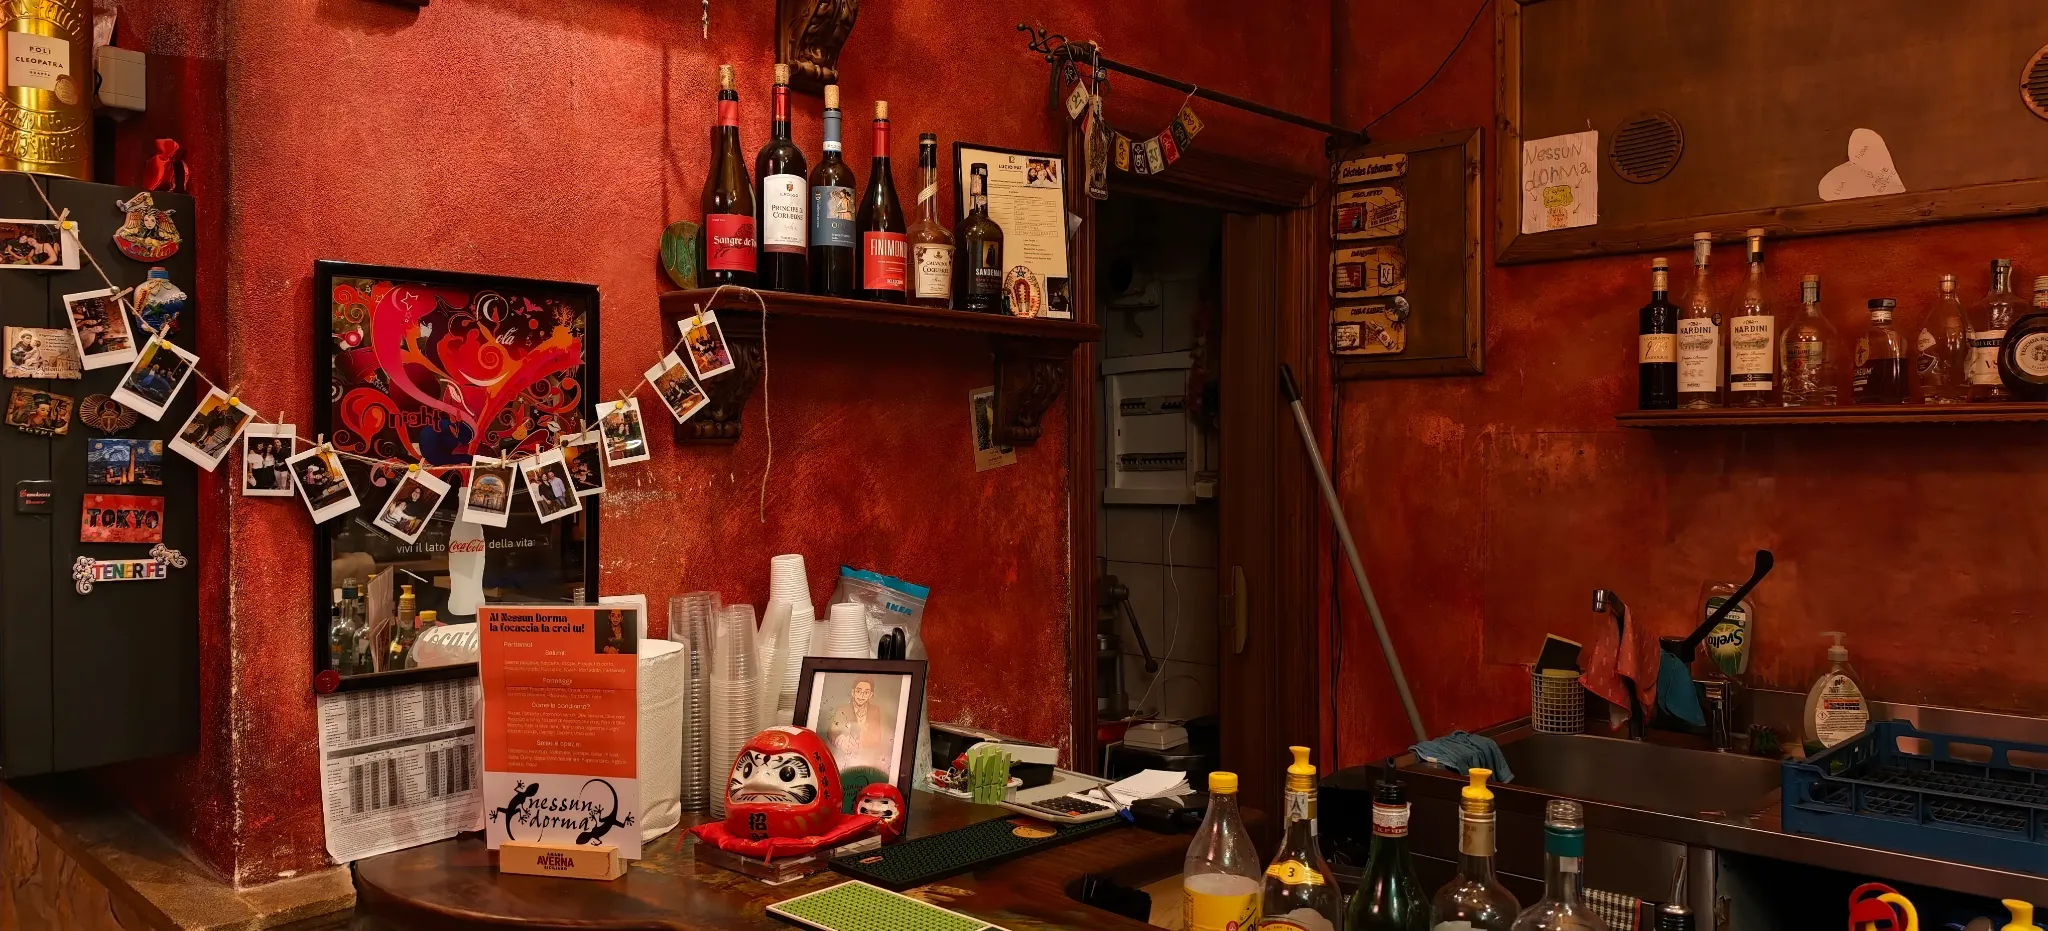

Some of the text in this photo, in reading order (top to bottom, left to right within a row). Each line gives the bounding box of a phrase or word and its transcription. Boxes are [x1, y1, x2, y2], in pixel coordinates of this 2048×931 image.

[29, 46, 51, 54] POLI
[15, 56, 64, 69] CLEOPATRA
[772, 205, 798, 213] PRINCIPE
[773, 212, 803, 220] CORLEONE
[713, 235, 742, 246] Sangre
[976, 268, 1001, 277] SANDEMA
[1680, 327, 1711, 335] NARDINI
[1735, 325, 1768, 333] NARDINI
[389, 407, 441, 432] night
[19, 426, 53, 436] EGYPT
[87, 508, 159, 529] TOKYO
[396, 544, 412, 553] vivi
[415, 543, 422, 552] il
[425, 542, 445, 552] lato
[489, 539, 513, 549] della
[886, 602, 913, 615] IKEA
[490, 613, 567, 622] Al Nessun Dorma
[490, 623, 585, 633] la focaccia la crei tu!
[1708, 629, 1744, 649] Svelto
[528, 797, 593, 811] nessun
[529, 810, 590, 830] dorma
[537, 856, 574, 868] AVERNA
[1288, 867, 1295, 877] 3
